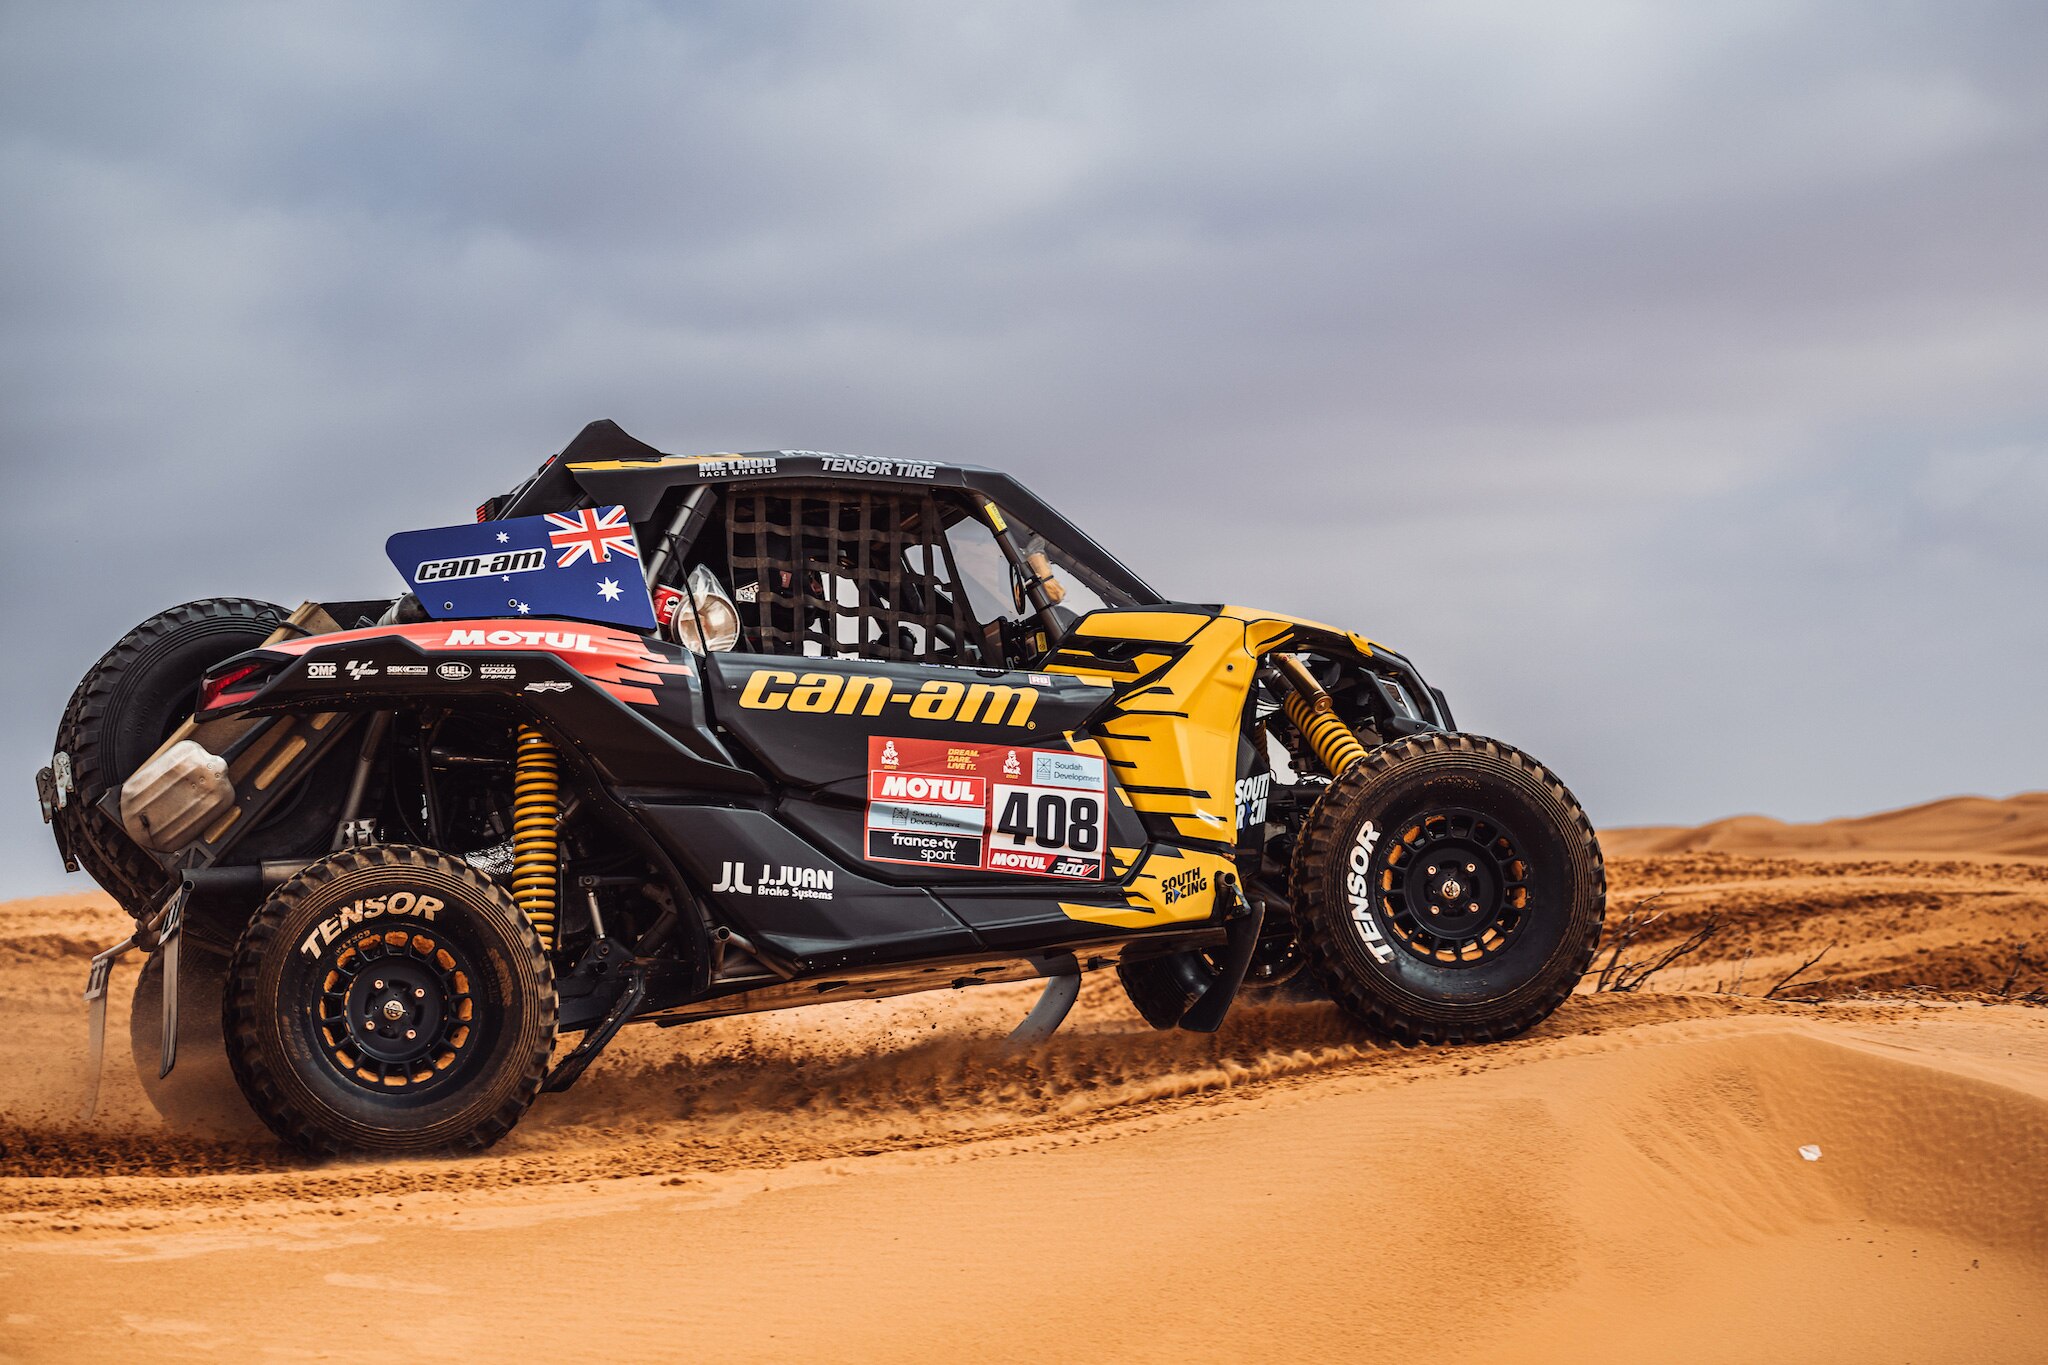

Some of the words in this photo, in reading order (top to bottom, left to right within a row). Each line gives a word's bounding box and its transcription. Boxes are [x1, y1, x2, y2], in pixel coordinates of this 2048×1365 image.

[699, 458, 776, 472] METHOD
[732, 467, 777, 475] WHEELS
[821, 457, 893, 475] TENSOR
[896, 463, 936, 479] TIRE
[418, 551, 543, 581] can-am
[444, 630, 598, 652] MOTUL
[308, 665, 337, 676] OMP
[441, 666, 469, 674] BELL
[739, 669, 1039, 728] can-am
[948, 749, 979, 757] DREAM.
[1054, 762, 1083, 771] Soudah
[1053, 772, 1101, 783] Development
[881, 776, 975, 801] MOTUL
[911, 810, 942, 819] Soudah
[997, 792, 1098, 852] 408
[910, 818, 961, 828] Development
[921, 849, 956, 861] sport
[991, 852, 1047, 870] MOTUL
[758, 864, 834, 890] J.JUAN
[1053, 862, 1099, 877] 300V
[1162, 867, 1201, 892] SOUTH
[758, 885, 789, 896] Brake
[792, 888, 833, 900] Systems
[1346, 819, 1396, 965] TENSOR
[300, 891, 444, 959] TENSOR
